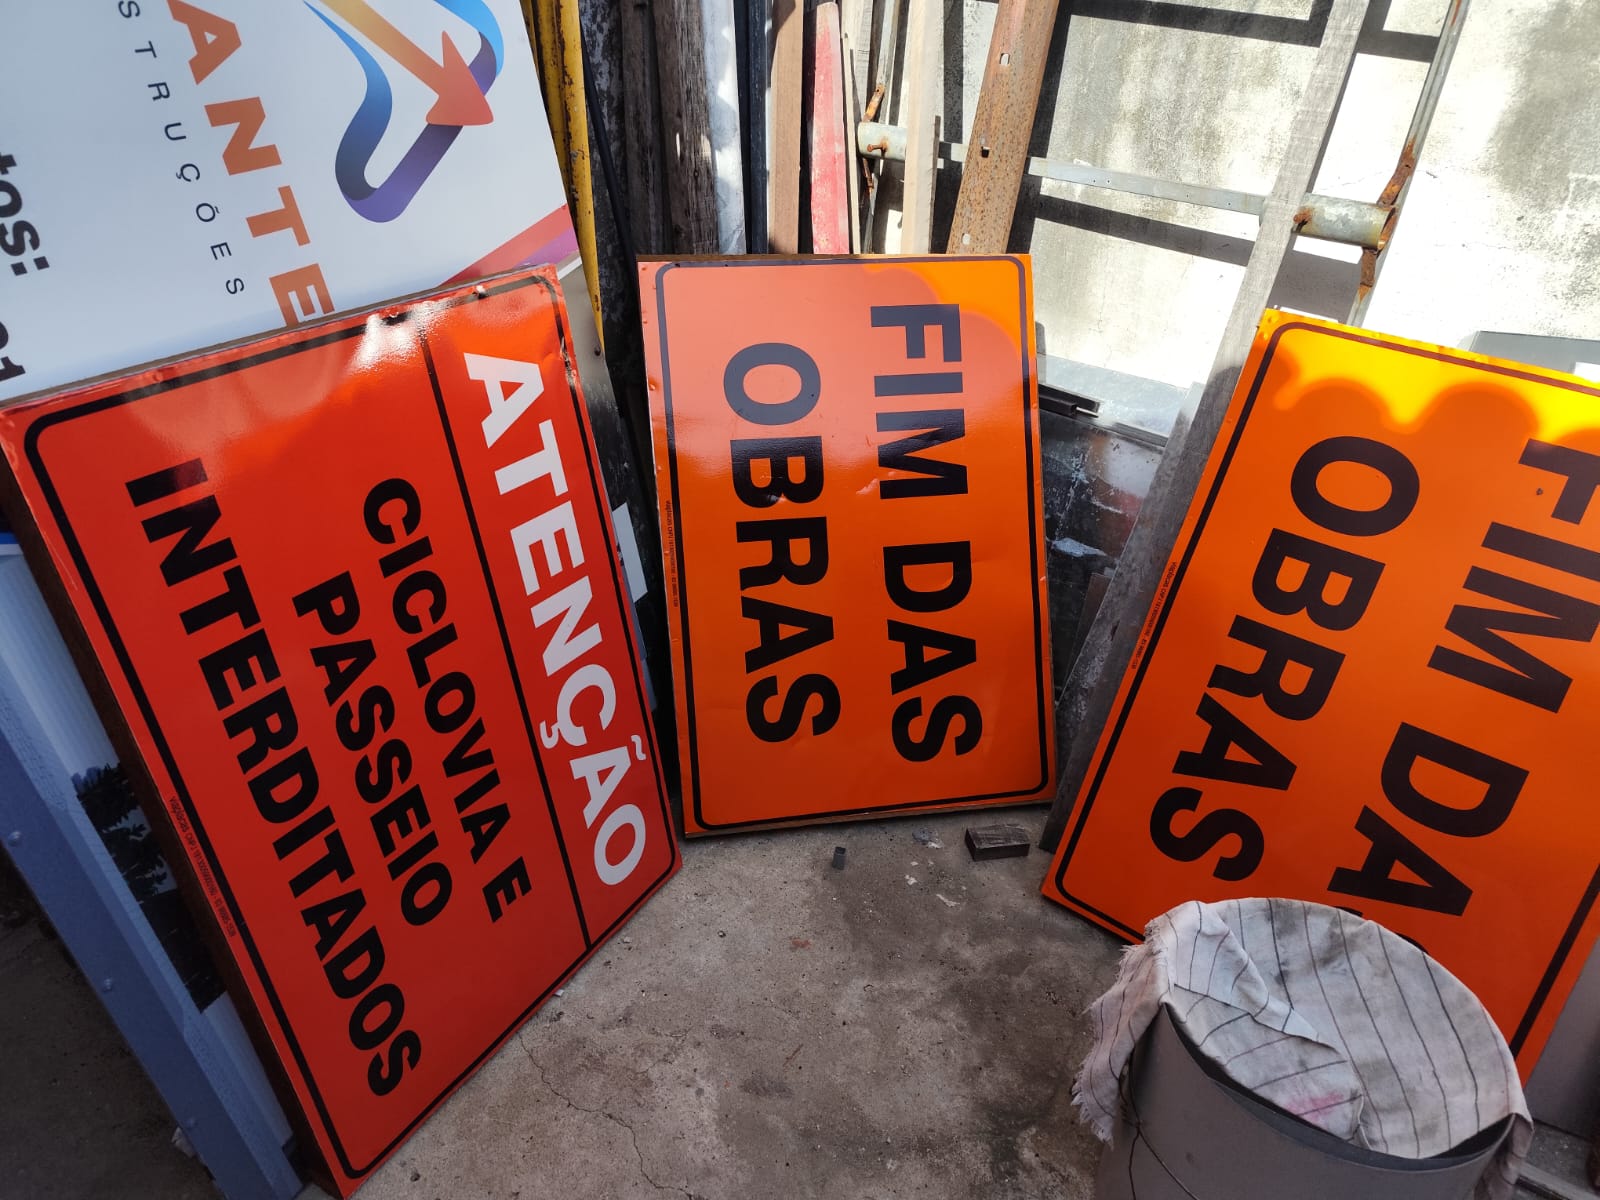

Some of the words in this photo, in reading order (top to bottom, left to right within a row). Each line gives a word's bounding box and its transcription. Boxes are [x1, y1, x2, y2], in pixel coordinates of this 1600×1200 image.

[723, 342, 842, 743] OBRAS
[871, 304, 969, 500] FIM
[126, 457, 422, 1097] INTERDITADOS
[292, 571, 453, 927] PASSEIO
[363, 479, 512, 865] CICLOVIA
[482, 856, 533, 924] E
[463, 353, 646, 885] ATENÇÃO
[883, 541, 983, 763] DAS
[1149, 436, 1420, 882] OBRAS
[1327, 722, 1530, 955] DA
